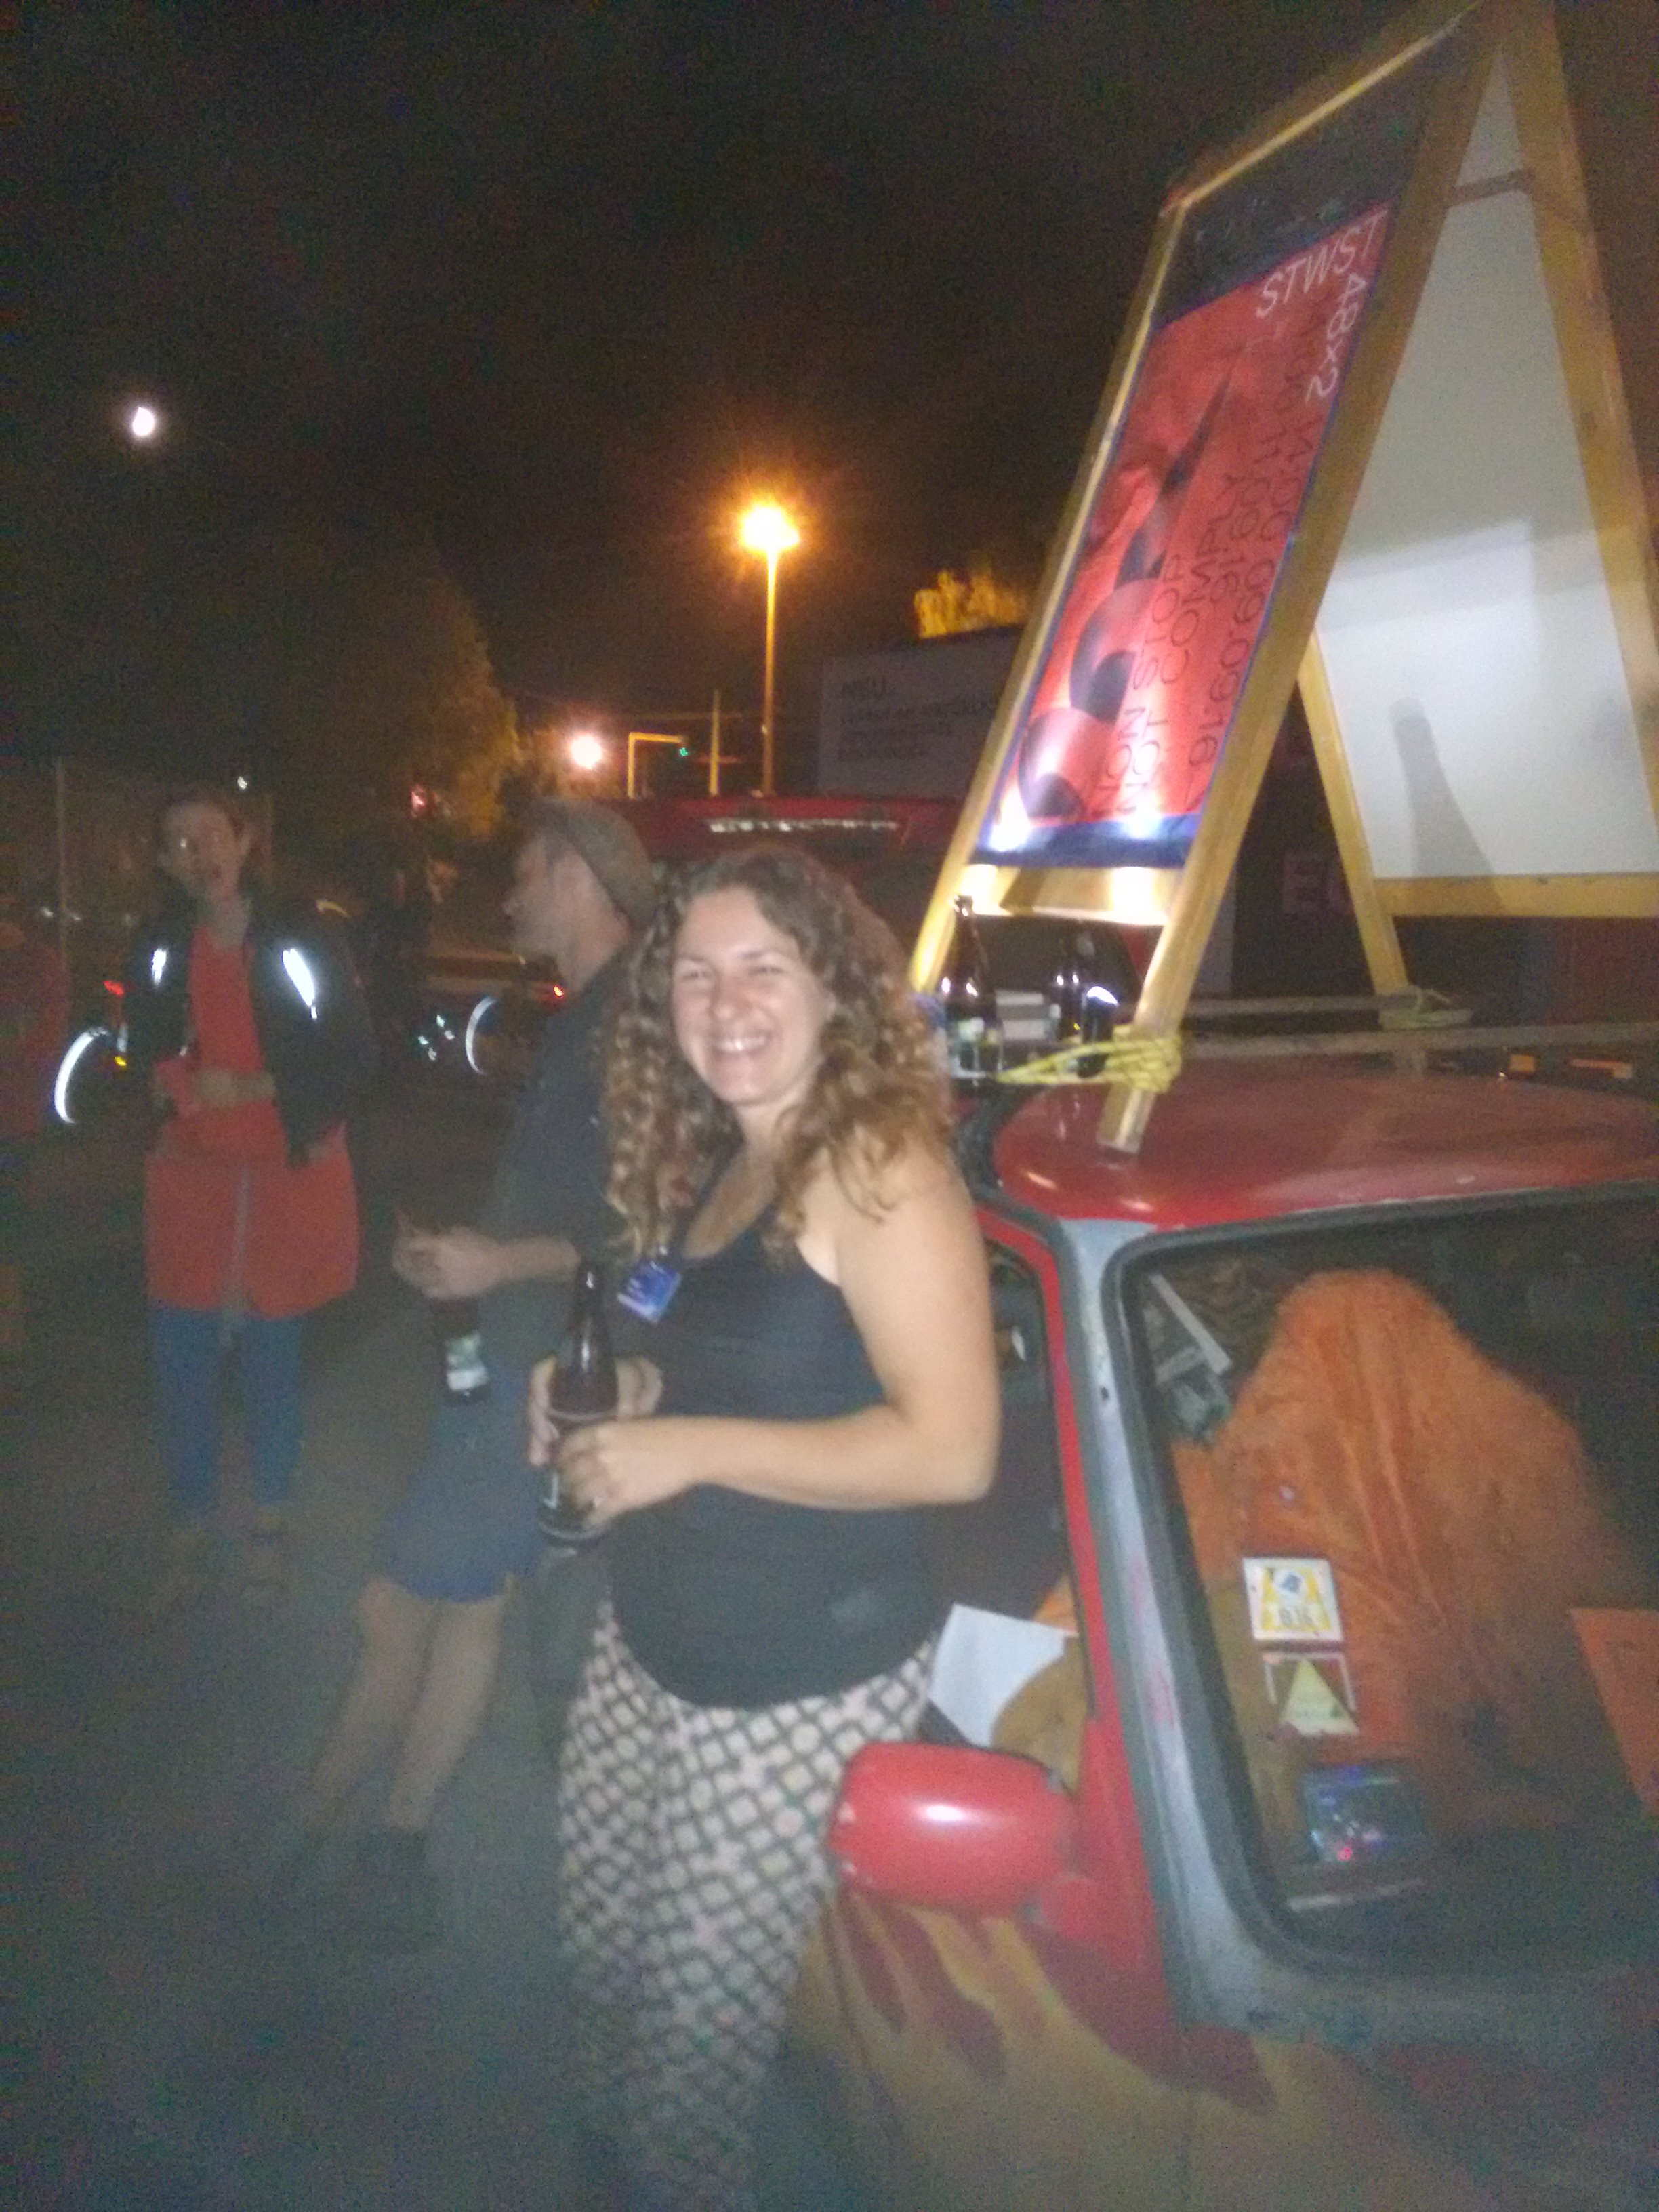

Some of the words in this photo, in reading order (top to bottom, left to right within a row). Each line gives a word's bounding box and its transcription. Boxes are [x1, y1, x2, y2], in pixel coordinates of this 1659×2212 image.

[1255, 209, 1389, 317] STWST
[1087, 708, 1147, 817] NON
[1132, 553, 1187, 690] STOP
[1115, 710, 1168, 812] NOT
[1160, 470, 1245, 683] COMPLY
